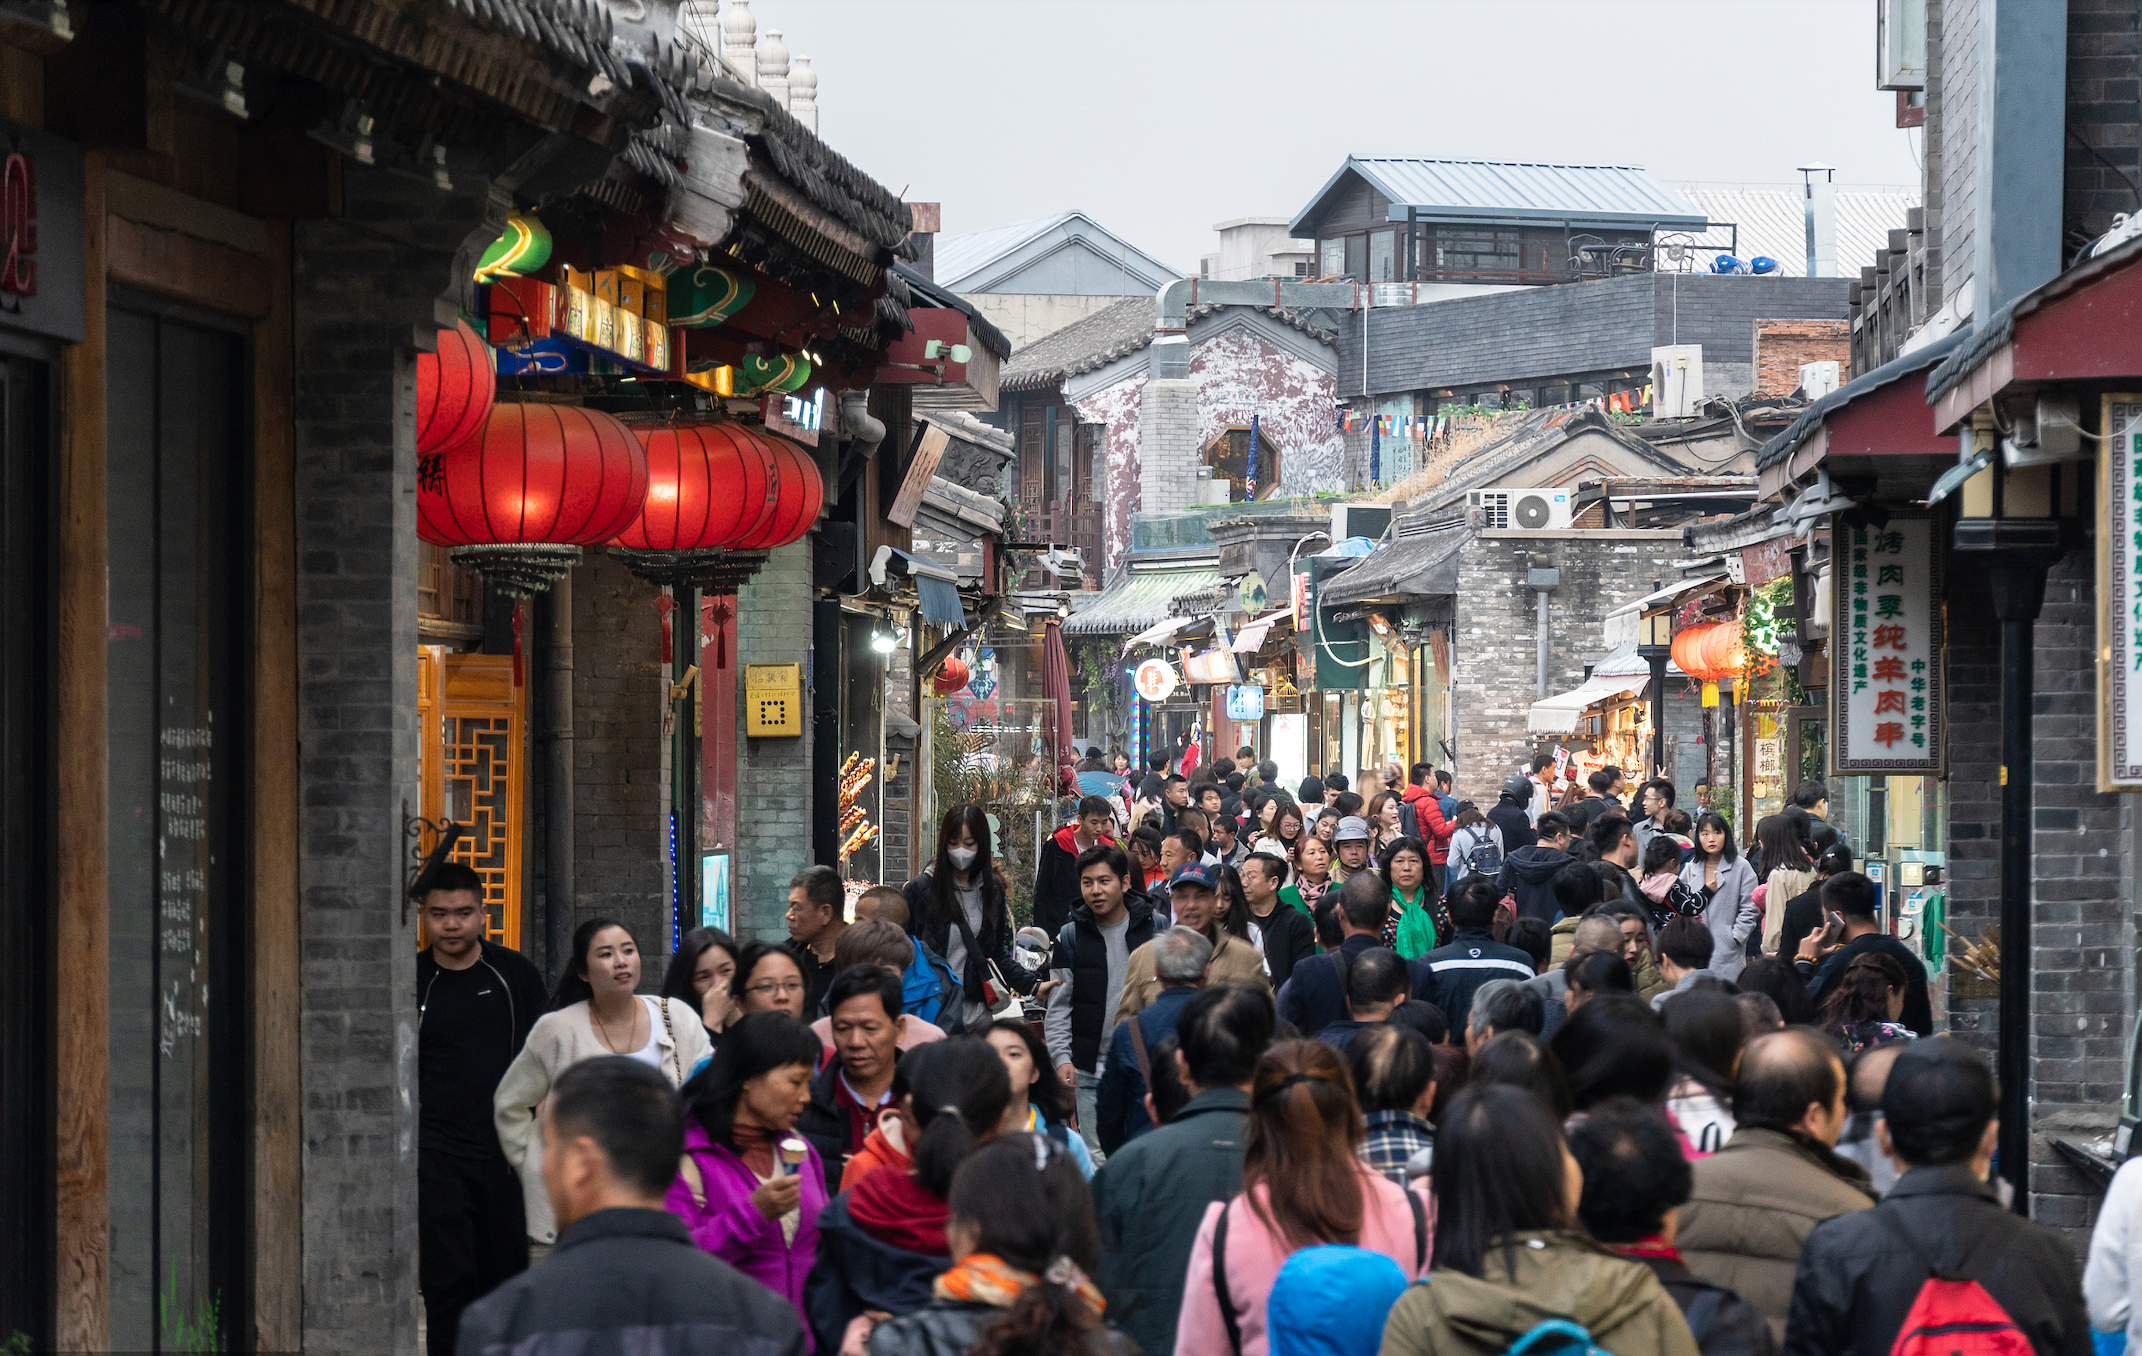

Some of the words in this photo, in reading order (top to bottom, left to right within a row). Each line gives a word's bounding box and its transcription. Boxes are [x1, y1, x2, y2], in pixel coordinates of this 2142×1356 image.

[1853, 530, 1868, 695] 国家级非物质文化遗产
[1910, 658, 1926, 749] 中华老字号
[1760, 742, 1776, 773] 槟榔
